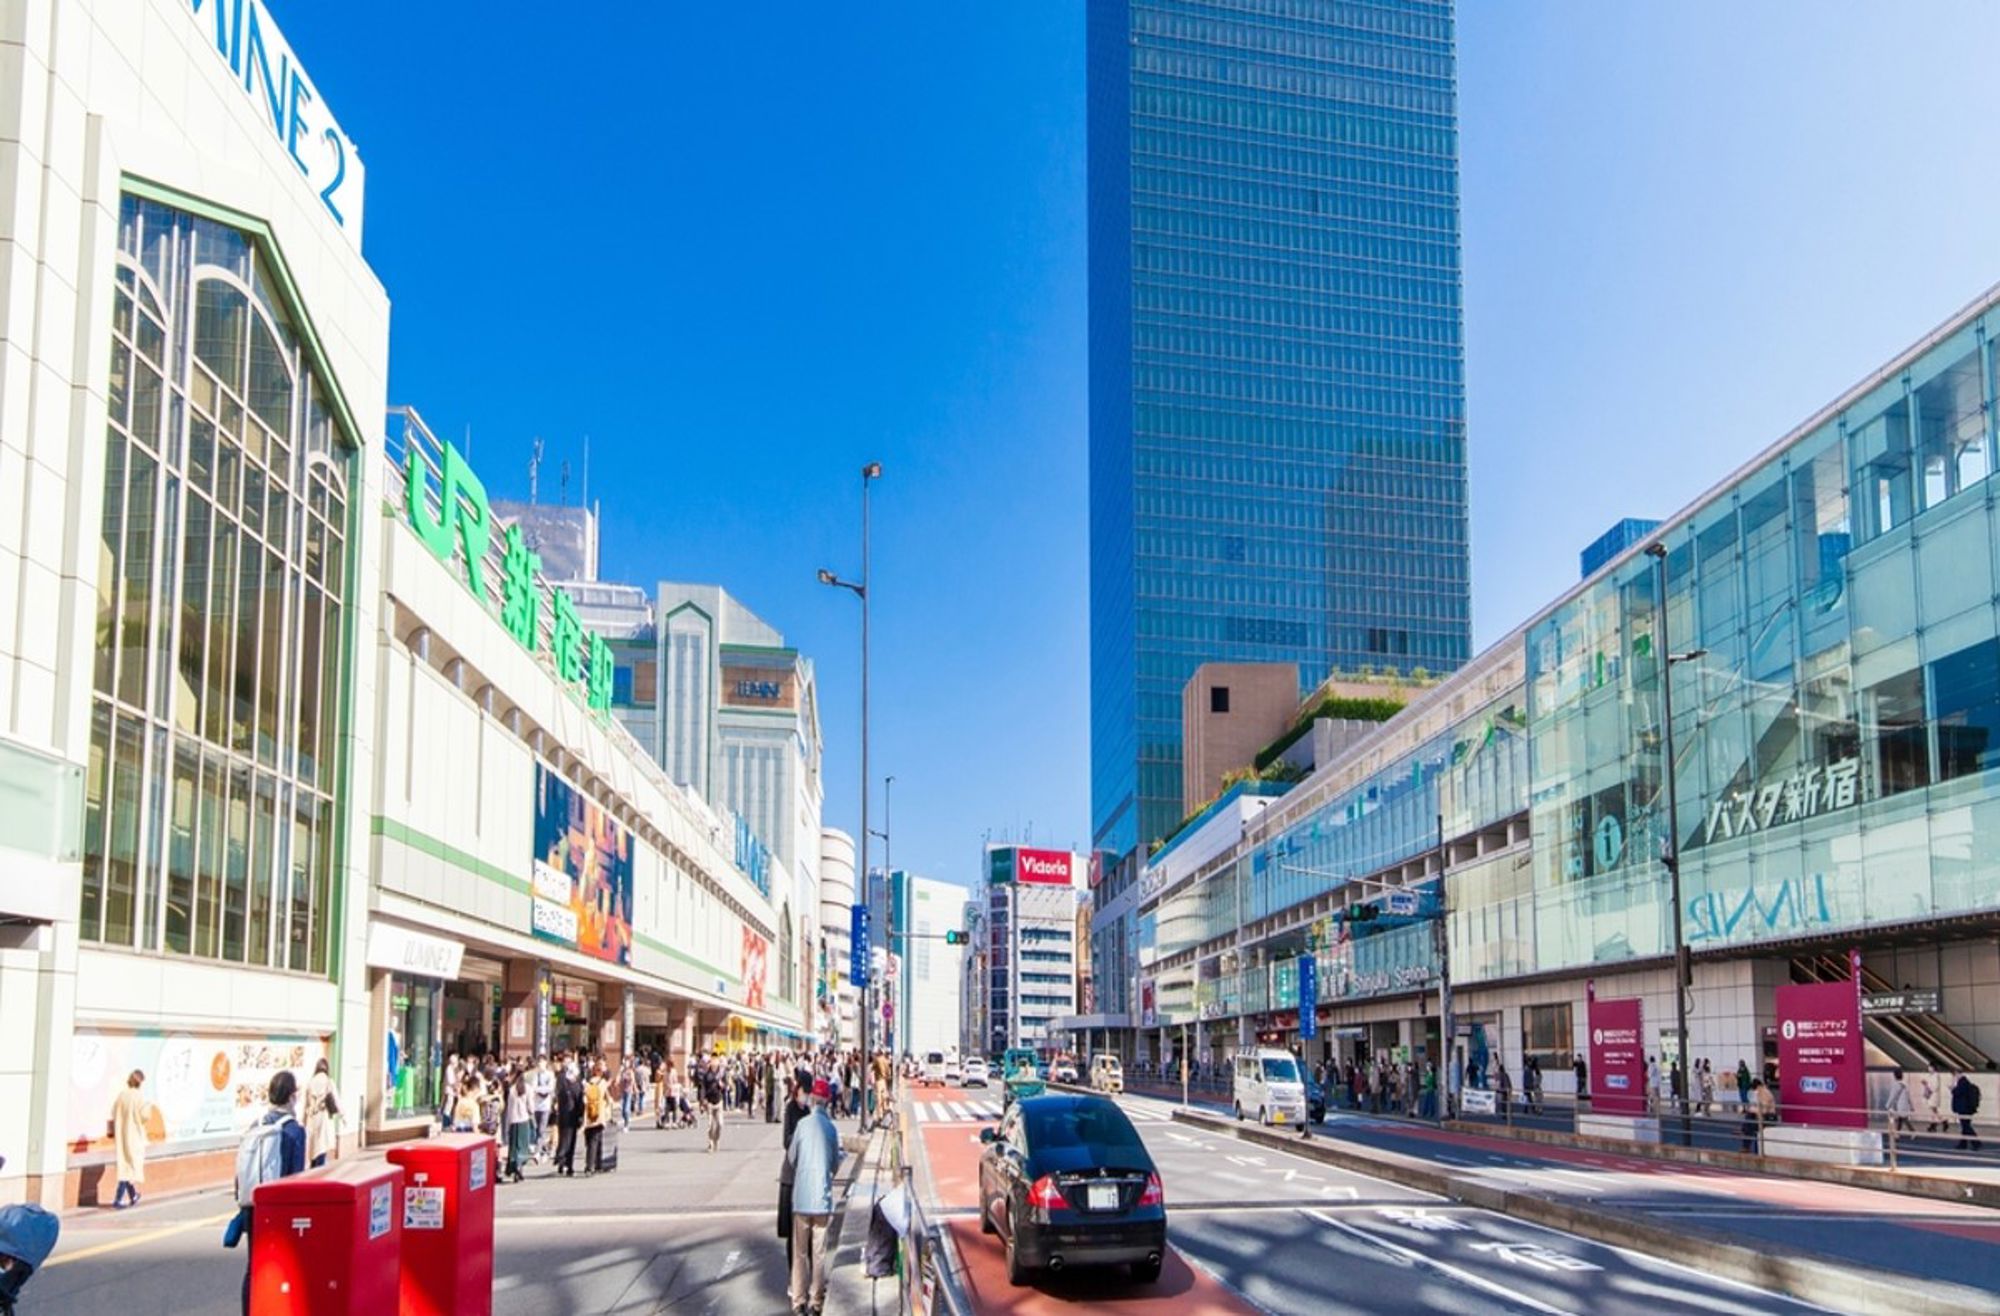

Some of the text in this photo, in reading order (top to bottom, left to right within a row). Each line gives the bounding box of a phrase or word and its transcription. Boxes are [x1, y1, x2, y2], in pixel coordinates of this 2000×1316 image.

[320, 127, 345, 228] 2
[1706, 756, 1861, 844] バスタ新宿
[1021, 856, 1068, 876] Victoria
